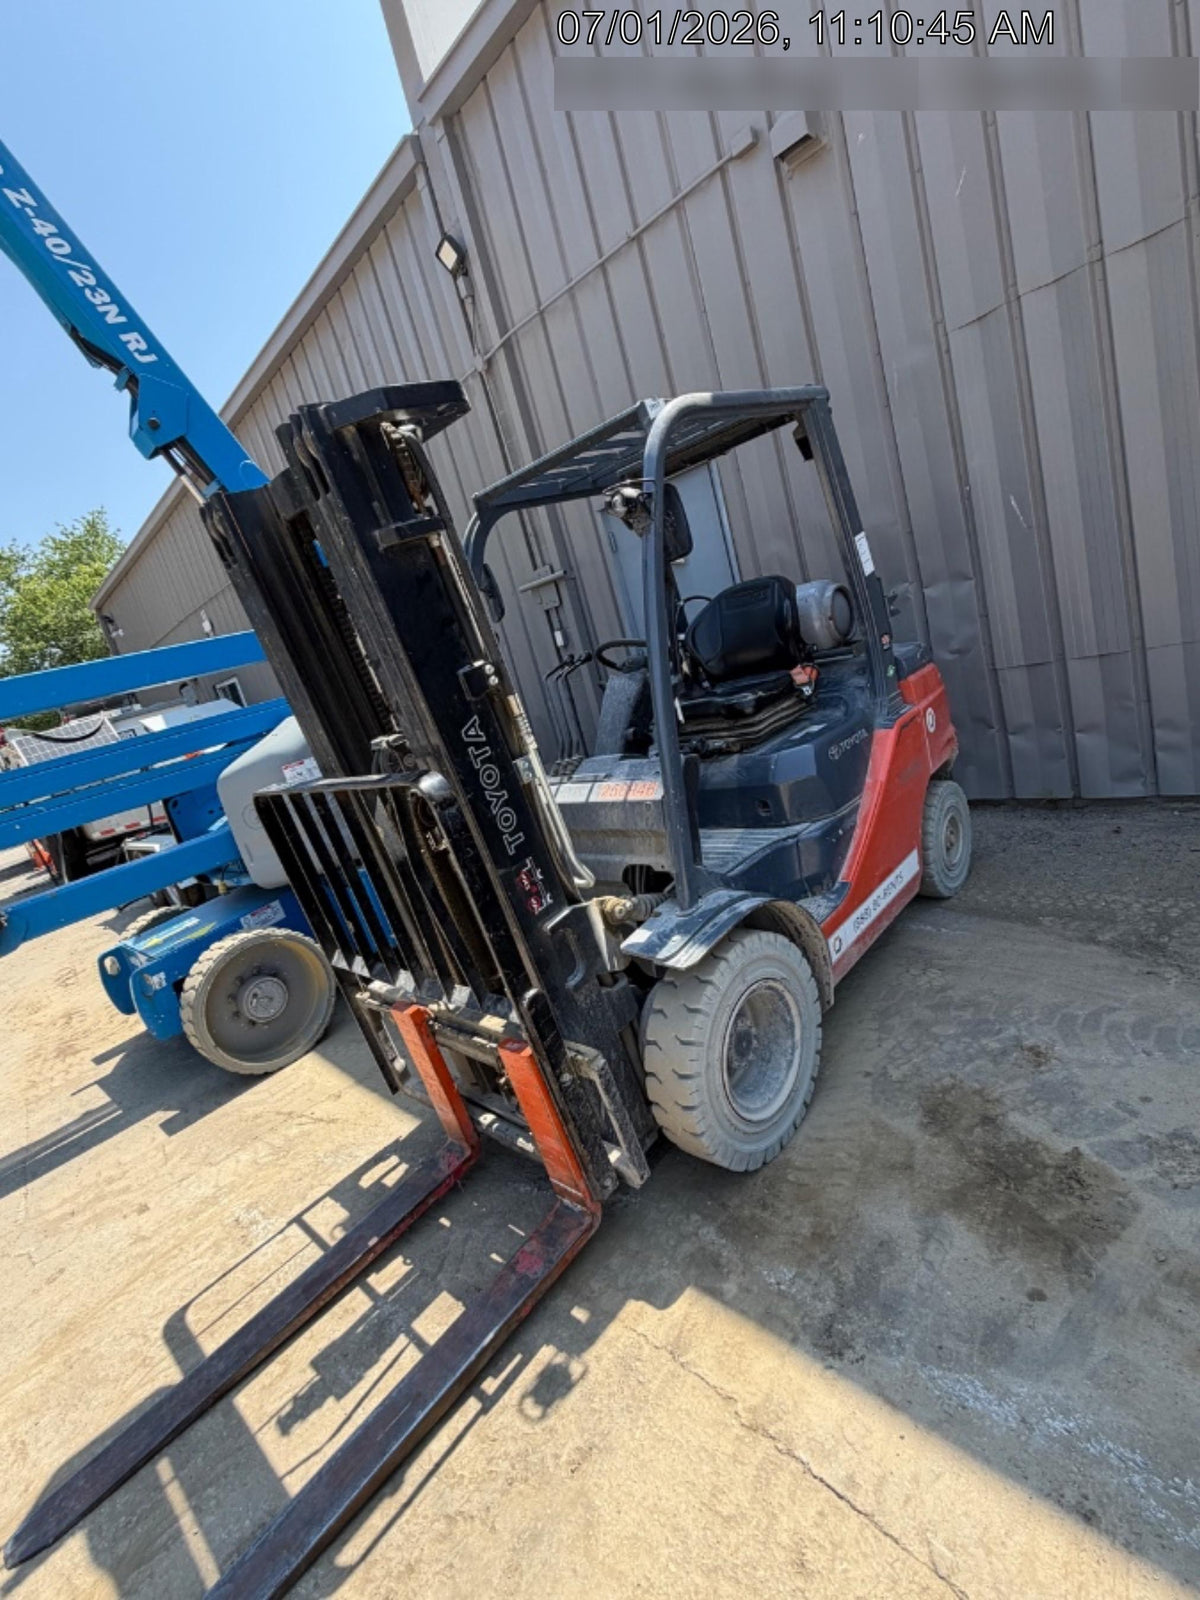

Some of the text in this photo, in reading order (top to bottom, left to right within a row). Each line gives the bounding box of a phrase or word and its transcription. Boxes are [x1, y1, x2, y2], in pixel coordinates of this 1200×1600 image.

[2, 187, 158, 363] Z-40/23N RJ
[461, 714, 525, 856] TOYOTA
[839, 728, 869, 752] TOYOTA
